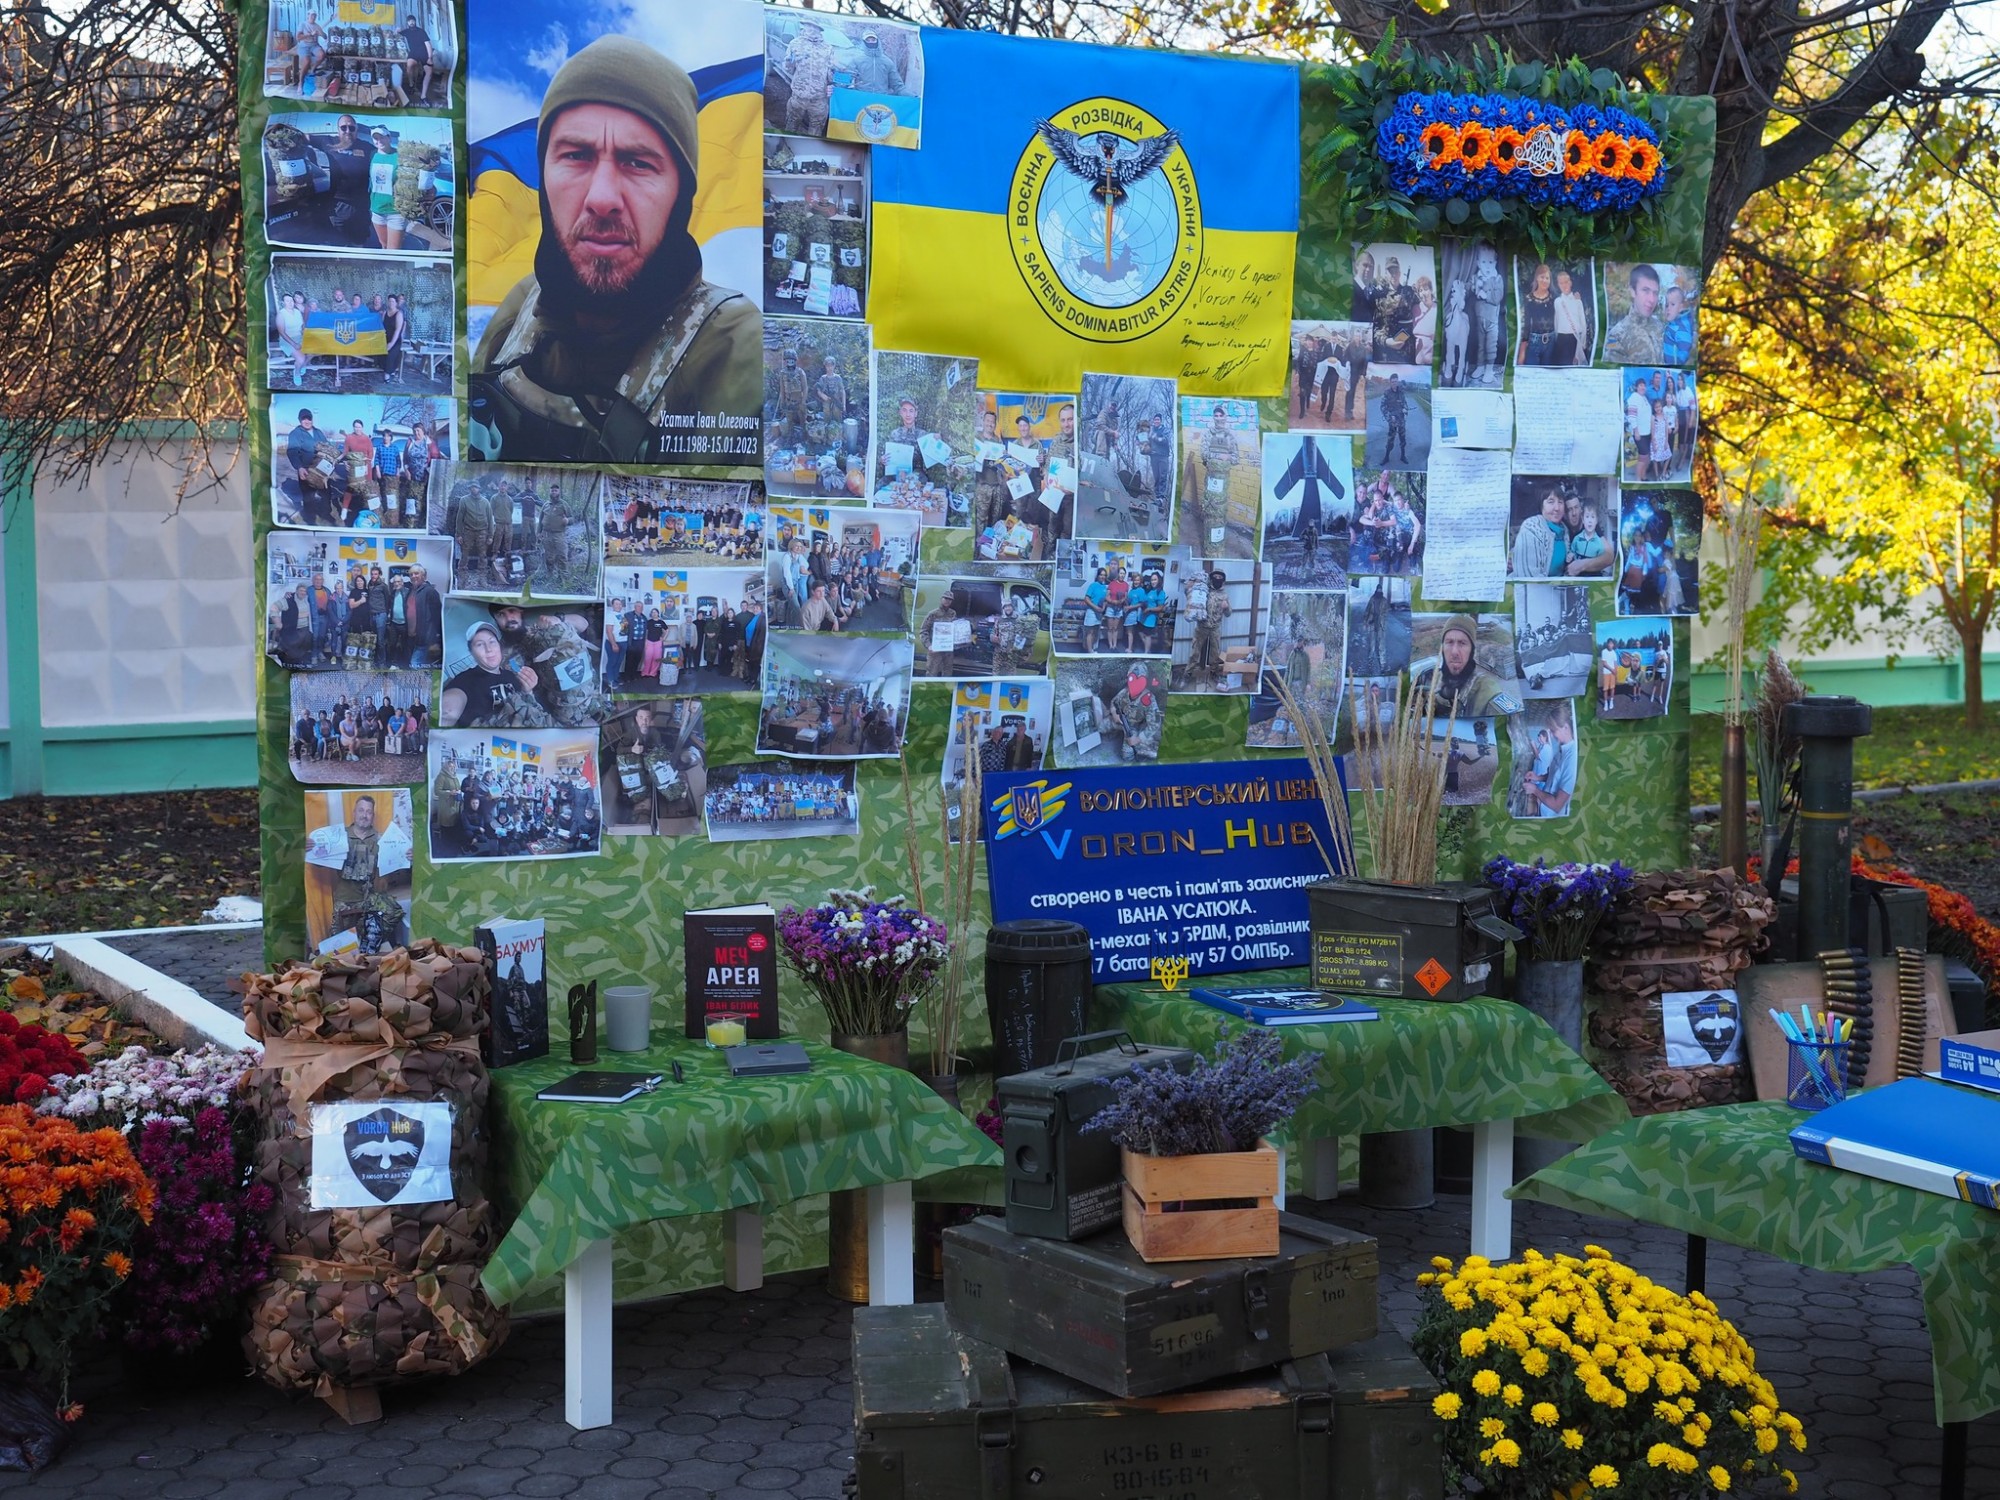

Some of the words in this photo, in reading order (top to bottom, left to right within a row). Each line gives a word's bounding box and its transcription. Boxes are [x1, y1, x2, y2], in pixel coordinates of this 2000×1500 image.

[1071, 107, 1144, 135] РОЗВІДКА
[1016, 151, 1047, 227] ВОЄННА
[1171, 161, 1197, 238] УКРАЇНИ
[1023, 251, 1066, 314] SAPIENS
[1065, 305, 1160, 333] DOMINABITUR
[1159, 259, 1193, 312] ASTRIS
[660, 411, 695, 428] Усатюк
[697, 411, 717, 429] Іван
[719, 411, 760, 430] Олегович
[660, 435, 758, 455] 17.11.1988-15.01.2023
[1079, 776, 1270, 813] ВОЛОНТЕРСЬКИЙ
[1275, 778, 1324, 801] ЦЕНТ
[1030, 888, 1111, 909] створено
[1115, 887, 1124, 902] в
[1127, 884, 1173, 901] честь
[1176, 881, 1181, 897] і
[1184, 878, 1243, 897] пам'ять
[1117, 906, 1169, 925] ІВАНА
[1171, 898, 1257, 921] УСАТЮКА.
[495, 936, 546, 960] БАХМУТ
[1340, 936, 1358, 944] FUZE
[715, 947, 749, 966] МЕЧ
[1208, 947, 1227, 963] 57
[1230, 943, 1295, 963] ОМПБр.
[1319, 956, 1343, 965] GROSS
[707, 967, 760, 985] АРЕЯ
[357, 1121, 389, 1135] VORON
[391, 1120, 411, 1134] HUB
